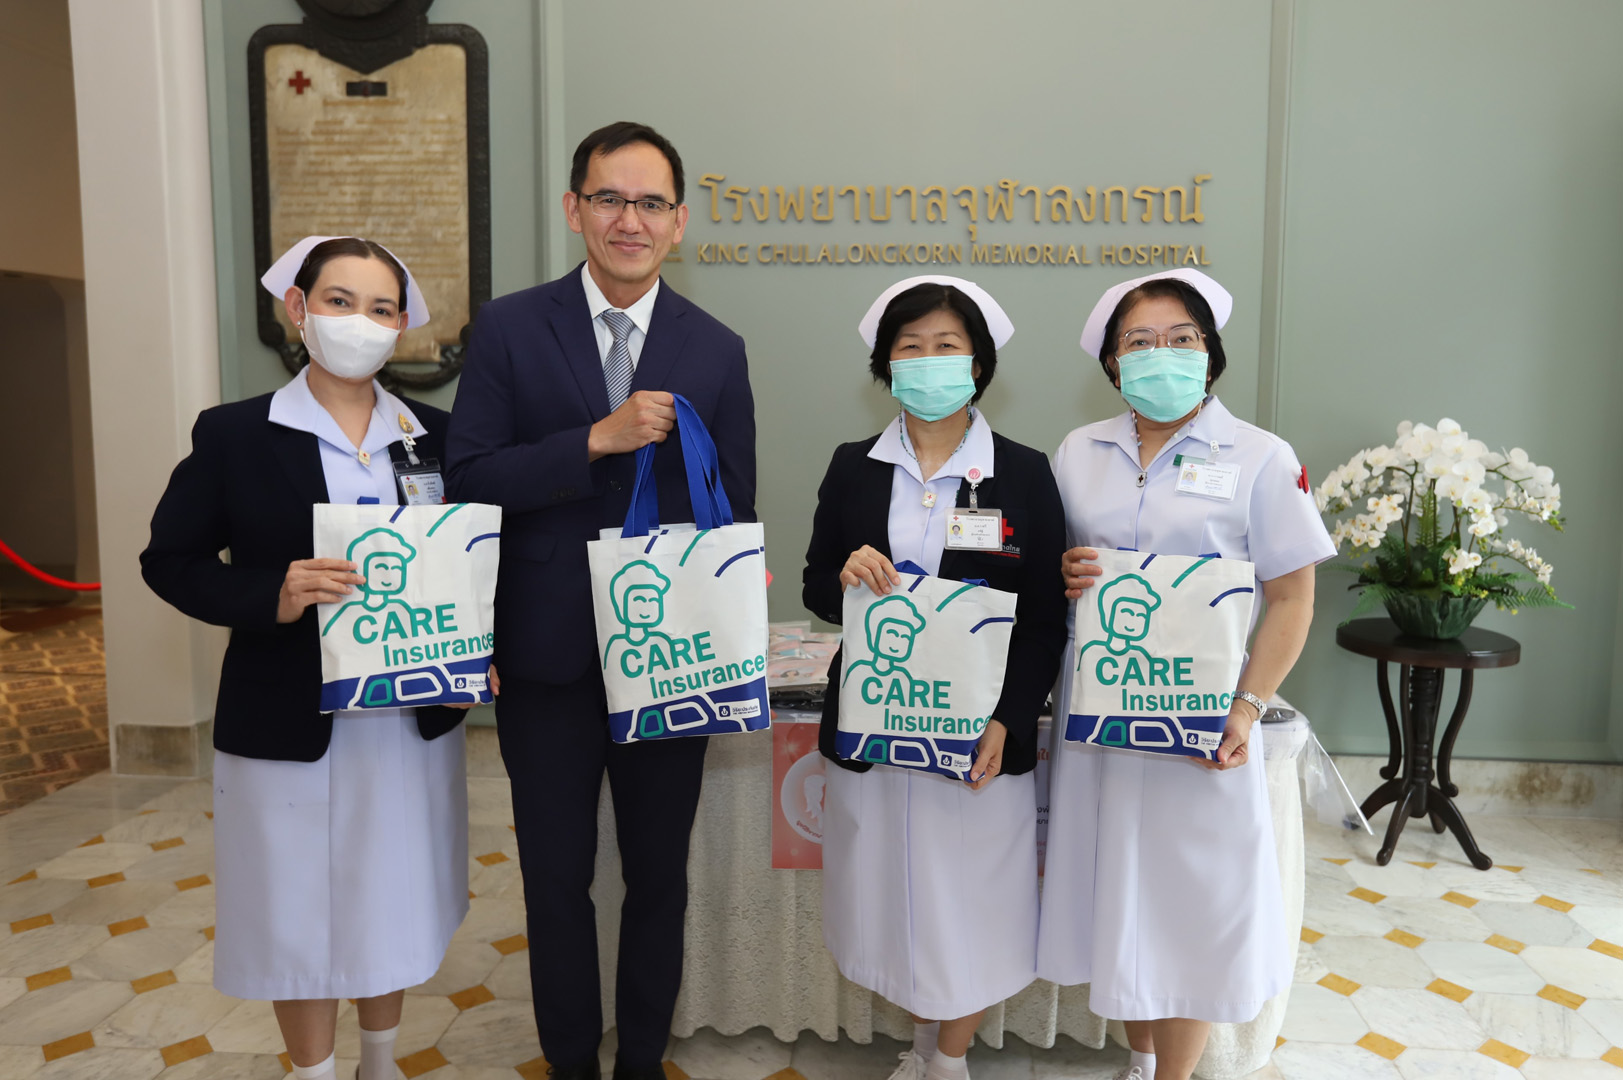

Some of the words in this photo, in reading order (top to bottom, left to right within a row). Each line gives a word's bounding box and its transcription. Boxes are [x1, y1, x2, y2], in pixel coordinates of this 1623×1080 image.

[697, 172, 1213, 242] โรงพยาบาลจุฬาลงกรณ์
[696, 242, 750, 264] KING
[756, 242, 963, 264] CHULALONGKORN
[970, 242, 1093, 265] MEMORIAL
[1100, 243, 1212, 266] HOSPITAL
[352, 602, 459, 645] CARE
[383, 631, 495, 667] Insurance
[620, 630, 717, 679] CARE
[649, 654, 765, 699] Insurance
[1095, 656, 1195, 686] CARE
[860, 676, 952, 710] CARE
